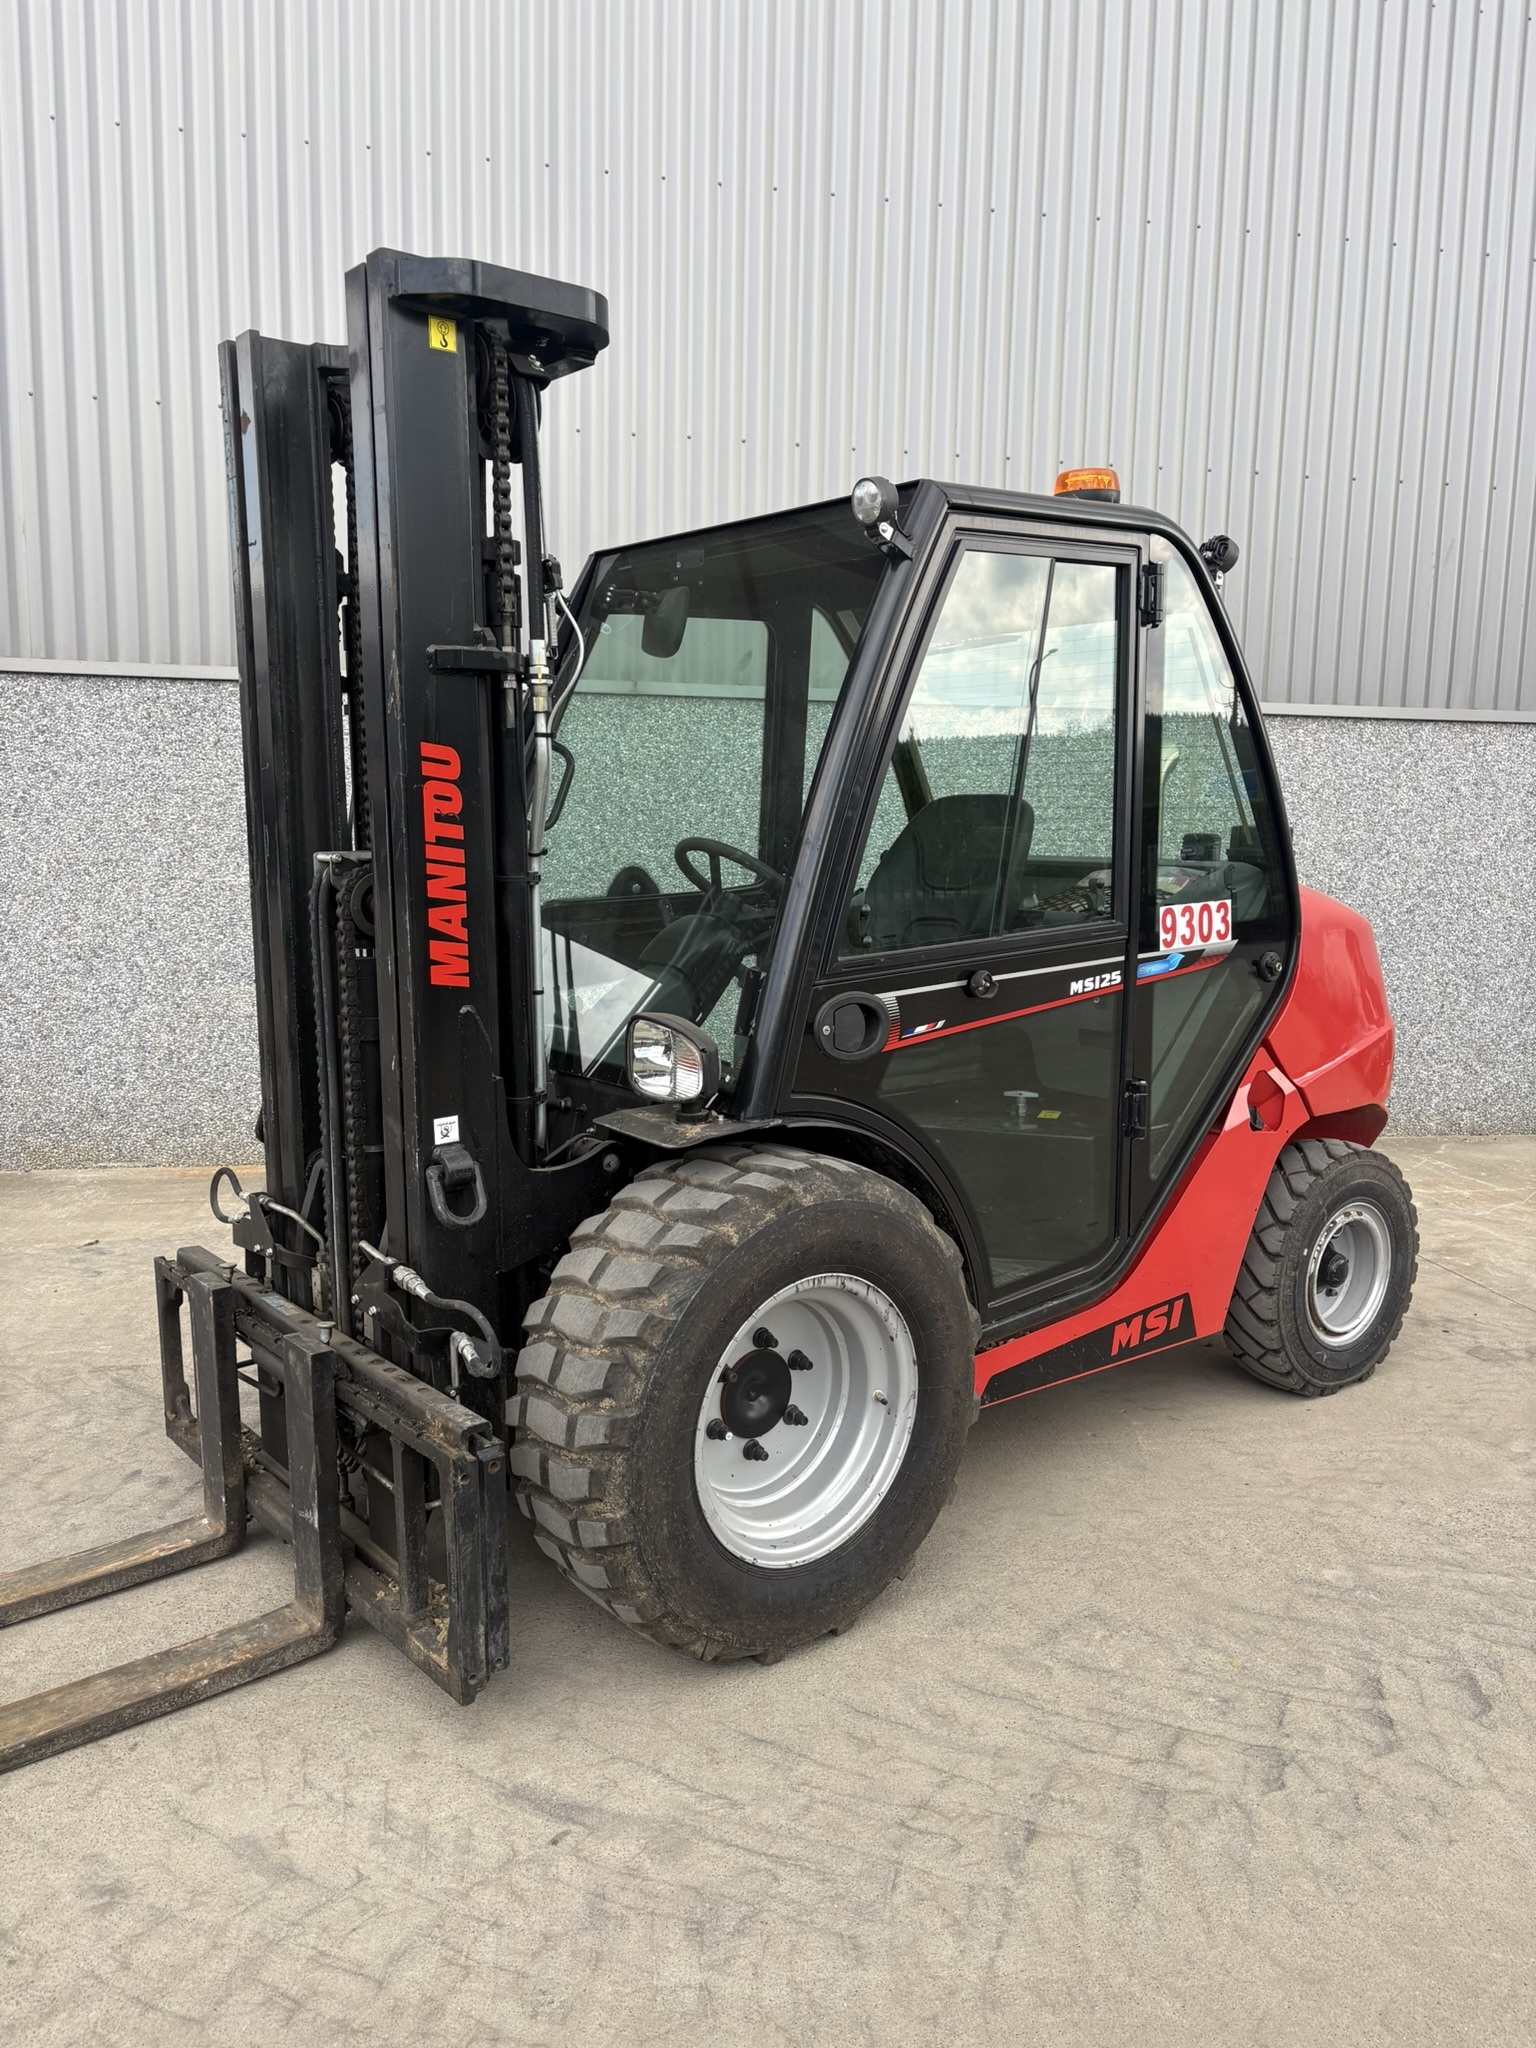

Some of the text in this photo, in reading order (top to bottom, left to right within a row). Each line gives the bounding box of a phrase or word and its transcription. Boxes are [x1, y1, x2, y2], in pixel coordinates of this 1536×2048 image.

[420, 741, 470, 988] MANITOU
[1161, 901, 1230, 949] 9303
[1069, 970, 1122, 996] MSI25
[1110, 1298, 1184, 1357] MSI
